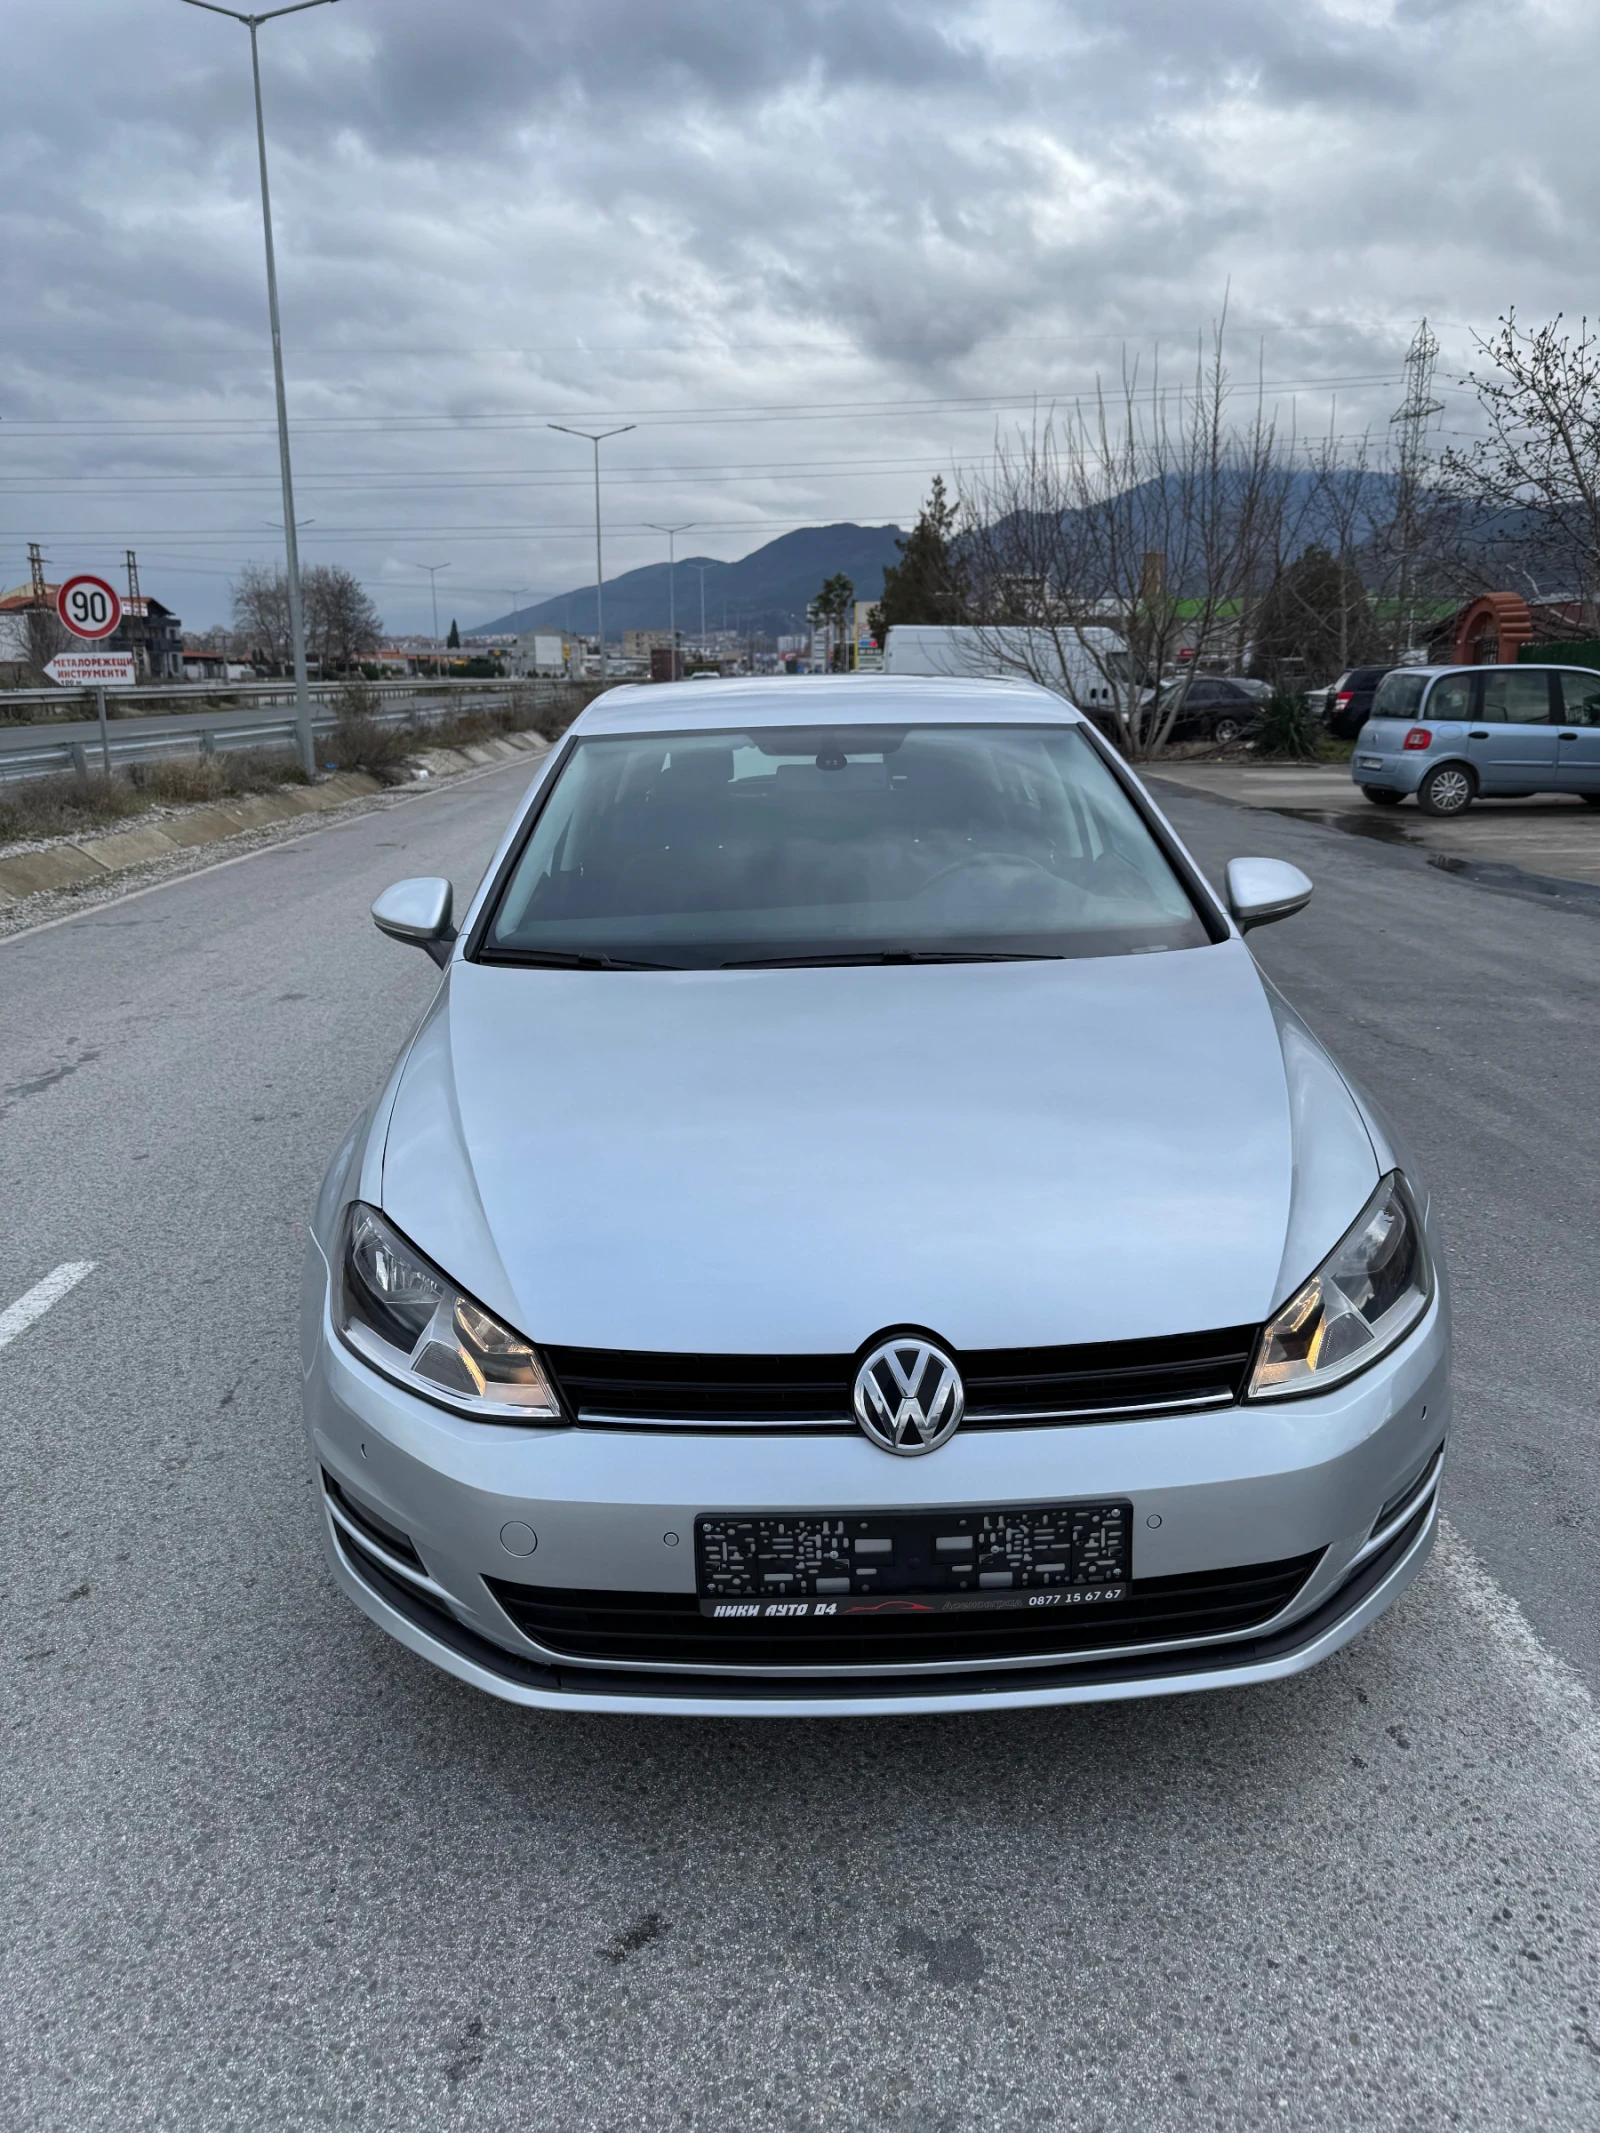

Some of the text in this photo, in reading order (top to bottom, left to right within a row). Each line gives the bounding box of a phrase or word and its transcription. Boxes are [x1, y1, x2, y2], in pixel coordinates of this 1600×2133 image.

[72, 591, 107, 623] 90
[53, 658, 134, 667] МЕТАЛОРЕЖЕЩИ
[57, 669, 127, 678] ИНСТРУМЕНТИ
[1028, 1589, 1122, 1606] 0877 15 67 67
[713, 1605, 760, 1617] НИКИ
[765, 1603, 808, 1616] АУТО
